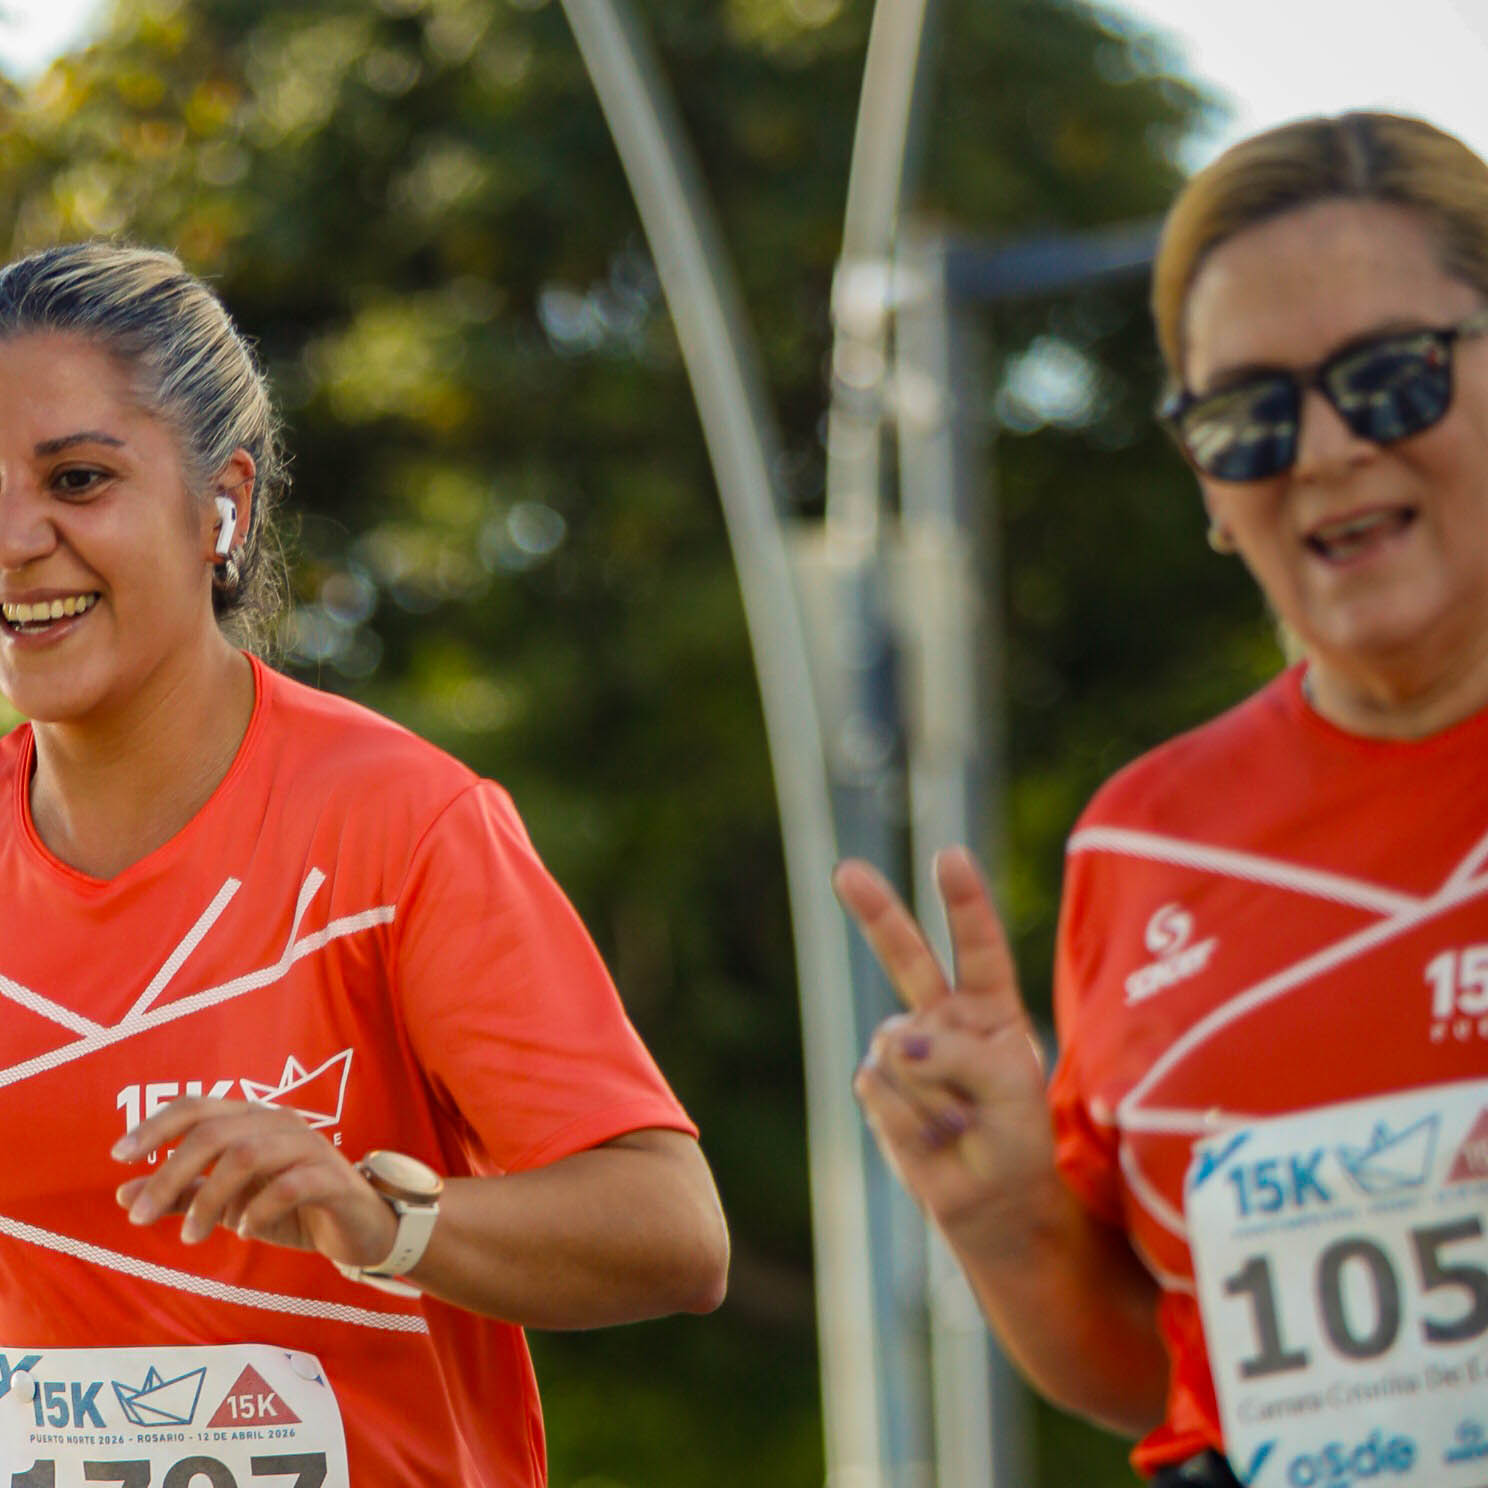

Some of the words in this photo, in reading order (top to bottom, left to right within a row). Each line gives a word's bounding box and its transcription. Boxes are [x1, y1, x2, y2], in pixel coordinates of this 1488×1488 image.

[1226, 1147, 1333, 1216] 15K
[31, 1381, 106, 1428] 15K
[227, 1392, 278, 1420] 15K
[30, 1434, 64, 1445] PUERTO
[67, 1435, 95, 1445] NORTE
[99, 1435, 124, 1445] 2026
[137, 1433, 184, 1443] ROSARIO
[198, 1432, 209, 1442] 12
[213, 1432, 227, 1441] DE
[231, 1430, 263, 1440] ABRIL
[268, 1428, 296, 1439] 2026
